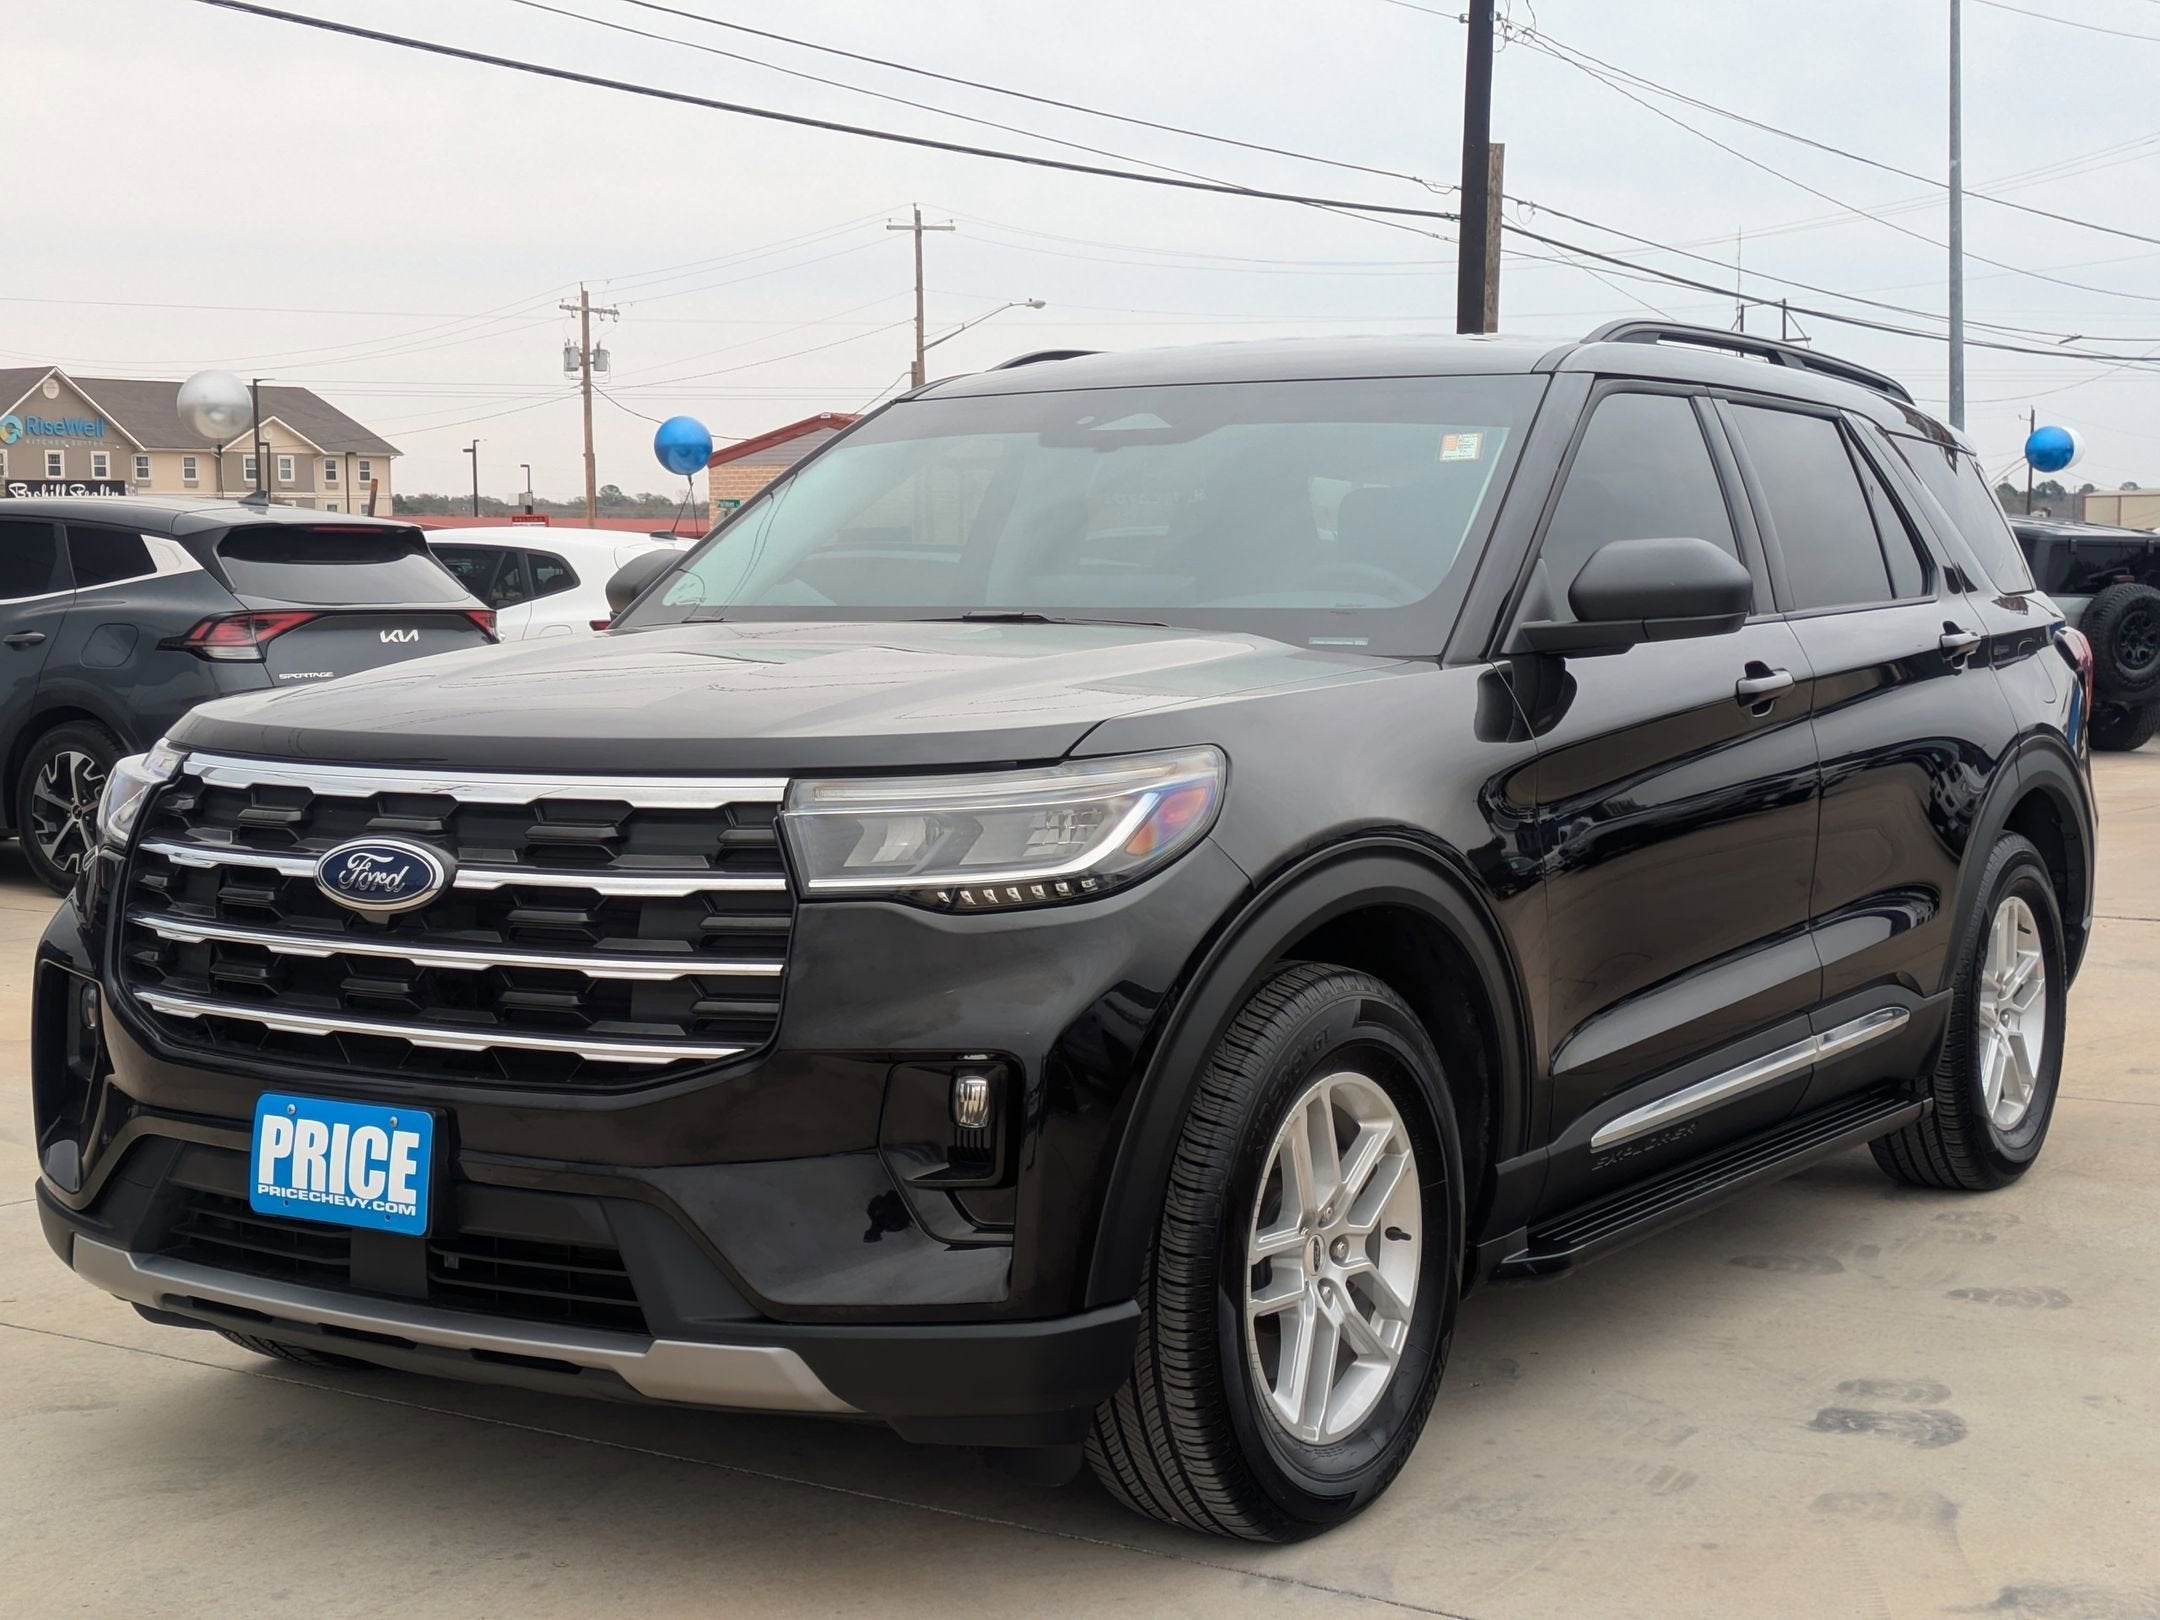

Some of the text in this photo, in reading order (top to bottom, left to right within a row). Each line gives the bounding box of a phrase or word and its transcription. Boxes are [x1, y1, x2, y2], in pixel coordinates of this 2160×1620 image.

[26, 415, 105, 437] RiseWell
[379, 629, 419, 643] KIA
[278, 671, 334, 680] SPORTAGE
[338, 852, 410, 892] Ford
[258, 1114, 420, 1205] PRICE
[257, 1184, 416, 1217] PRICECHEVY.COM
